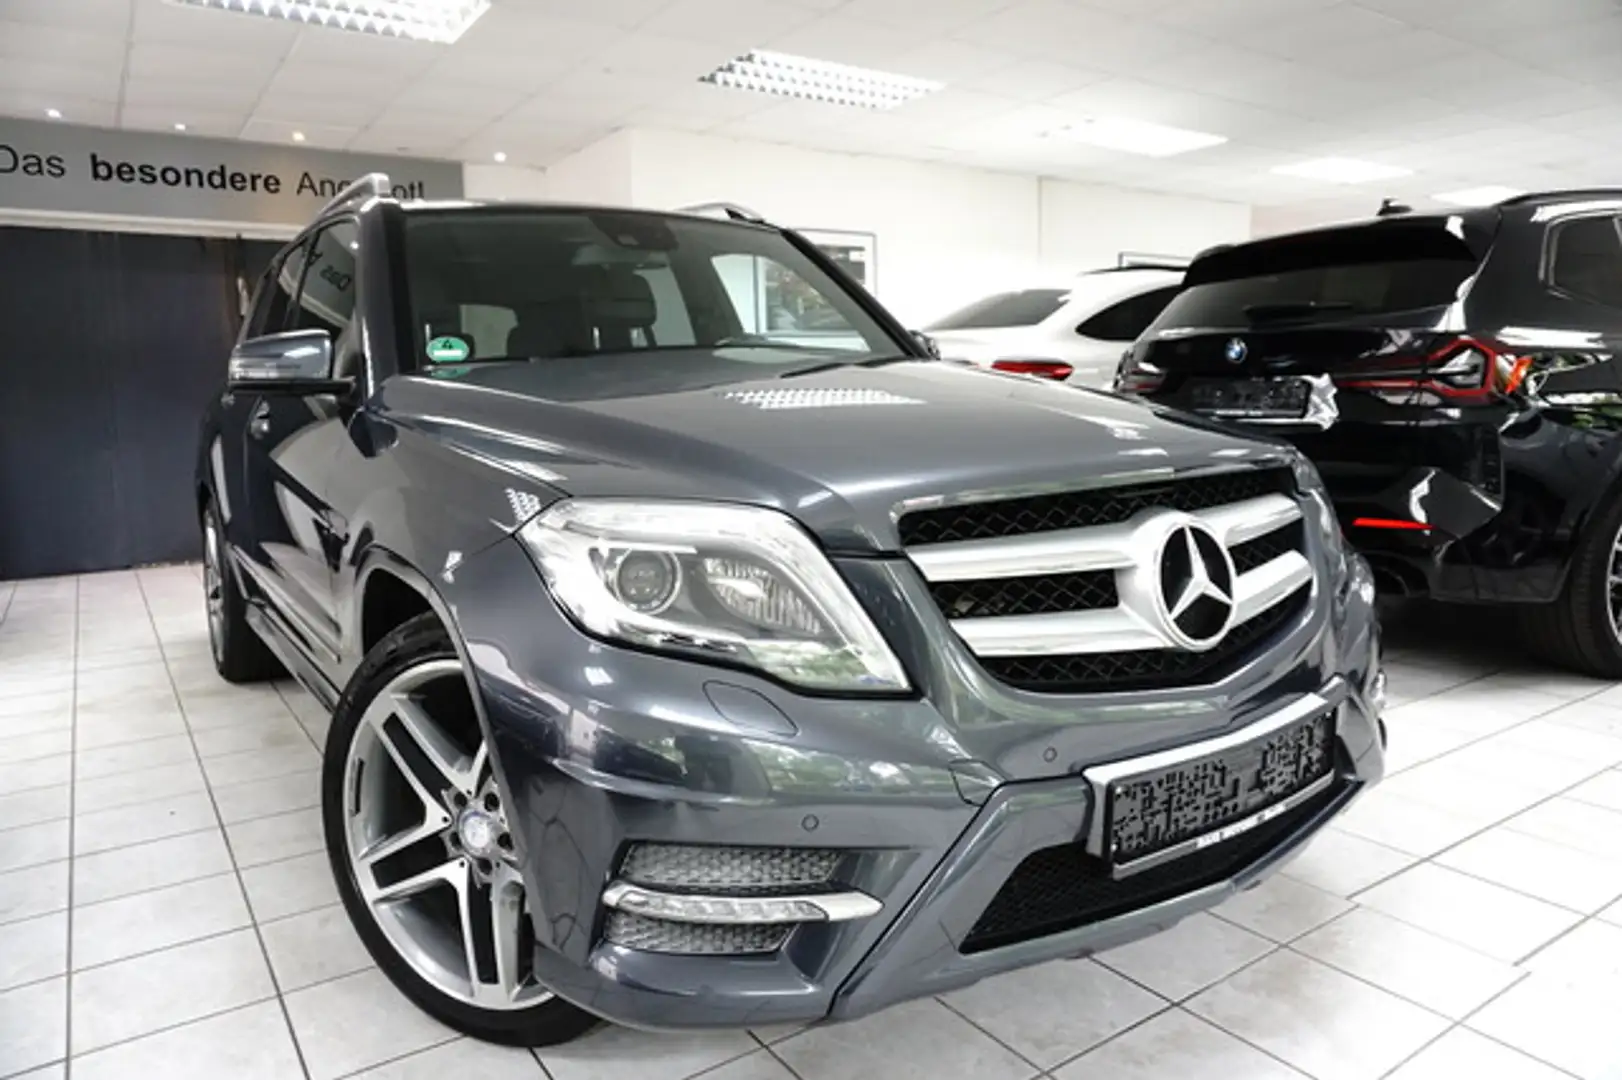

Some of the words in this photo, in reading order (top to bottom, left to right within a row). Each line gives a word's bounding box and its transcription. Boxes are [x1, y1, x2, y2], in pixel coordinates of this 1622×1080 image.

[0, 144, 66, 178] Das
[89, 152, 281, 194] besondere
[296, 171, 424, 200] Anot!
